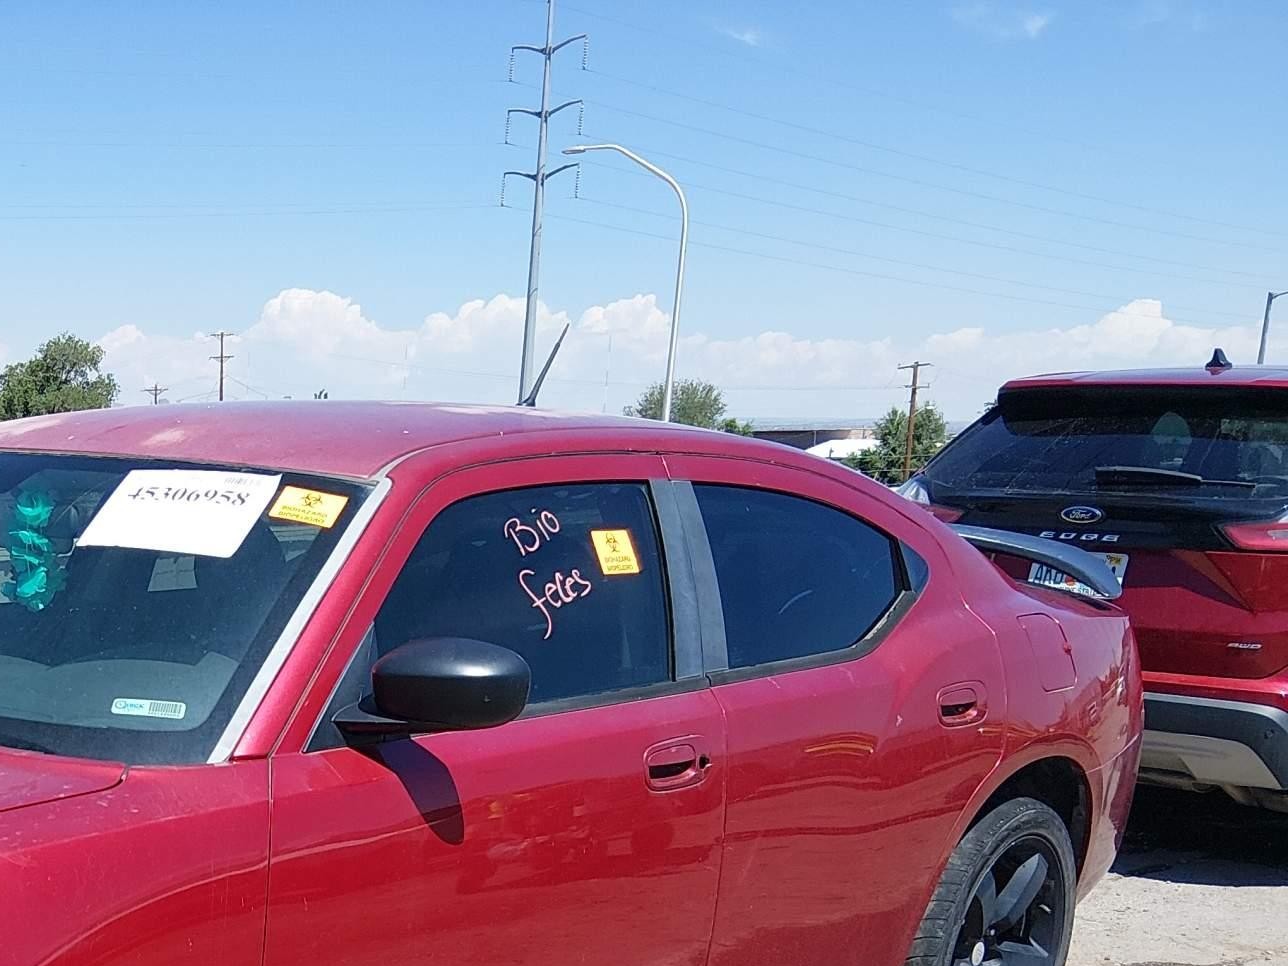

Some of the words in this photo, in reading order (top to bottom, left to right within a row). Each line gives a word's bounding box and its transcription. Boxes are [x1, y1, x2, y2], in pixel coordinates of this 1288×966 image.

[128, 487, 250, 506] 45306958
[1039, 531, 1120, 541] EDGE
[1226, 642, 1263, 650] AWD
